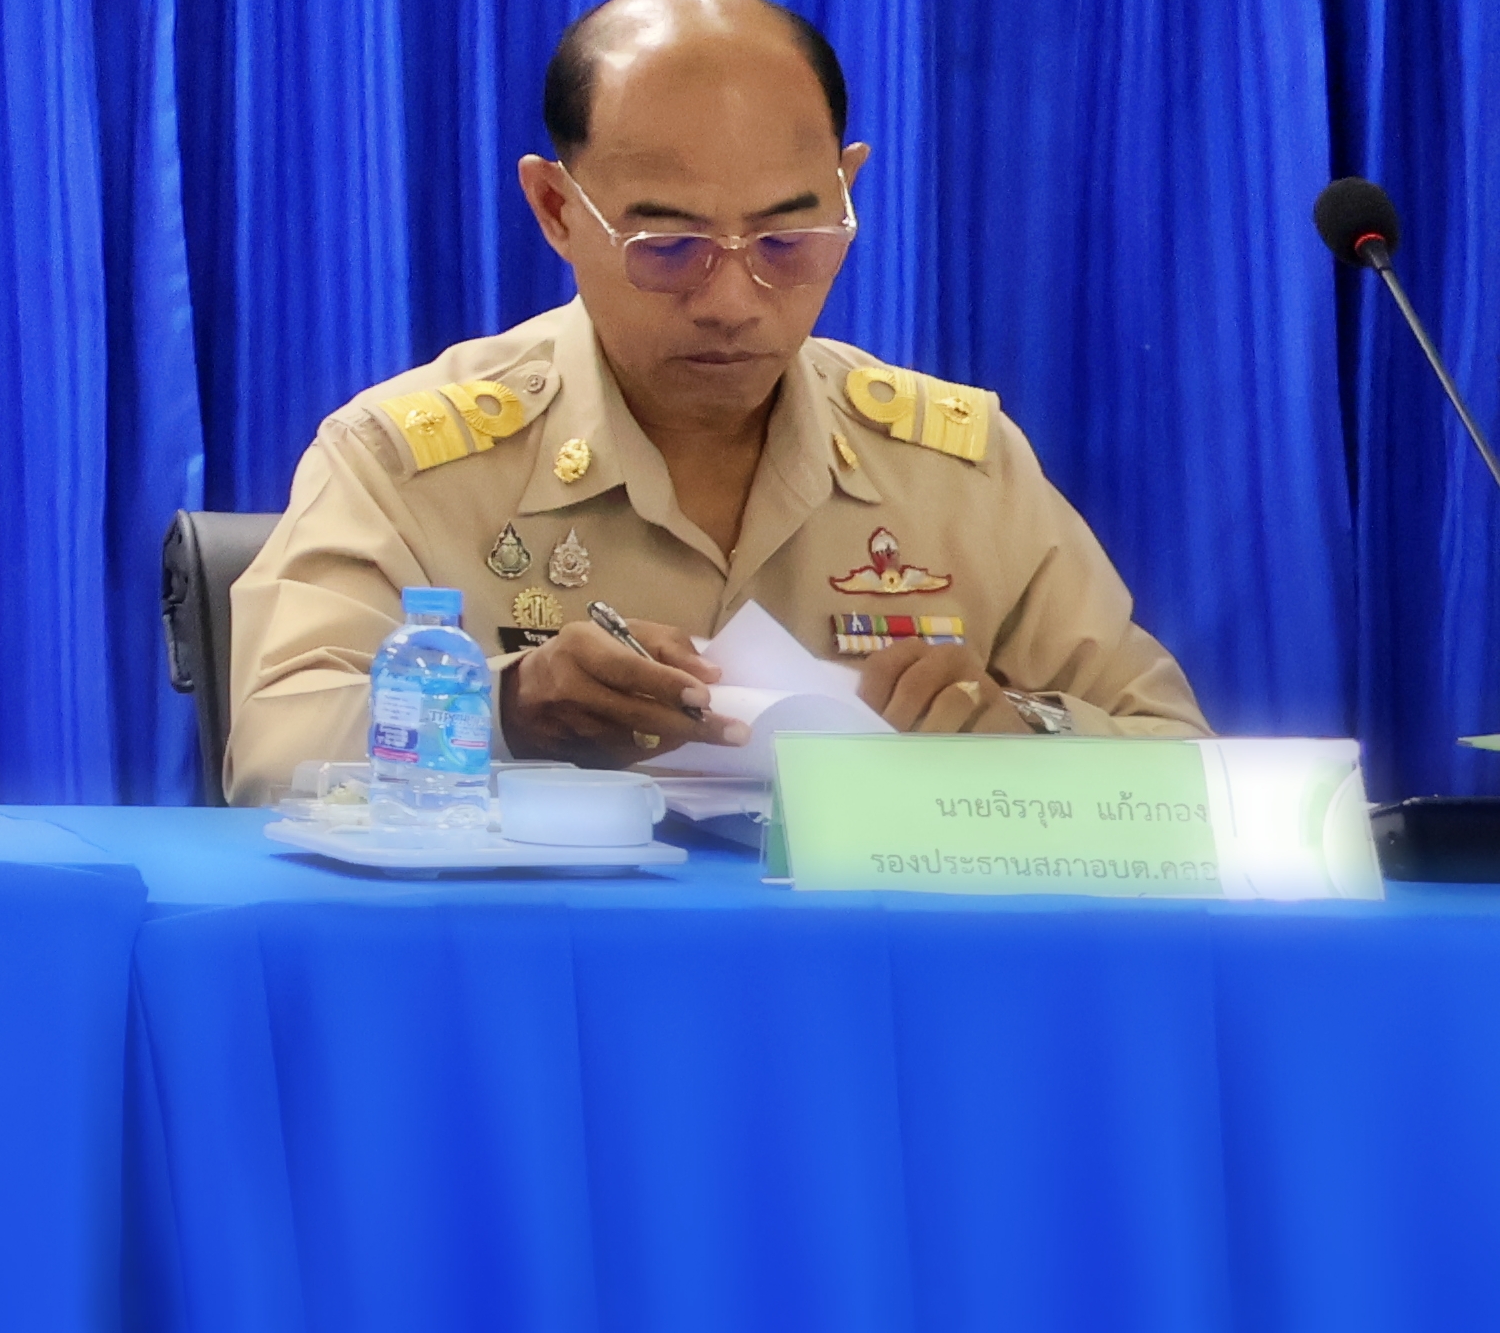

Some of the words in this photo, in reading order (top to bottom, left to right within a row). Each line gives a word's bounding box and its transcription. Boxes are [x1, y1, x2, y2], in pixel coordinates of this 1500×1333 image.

[869, 847, 1220, 883] รองประธานสภาอบต.คลอ
